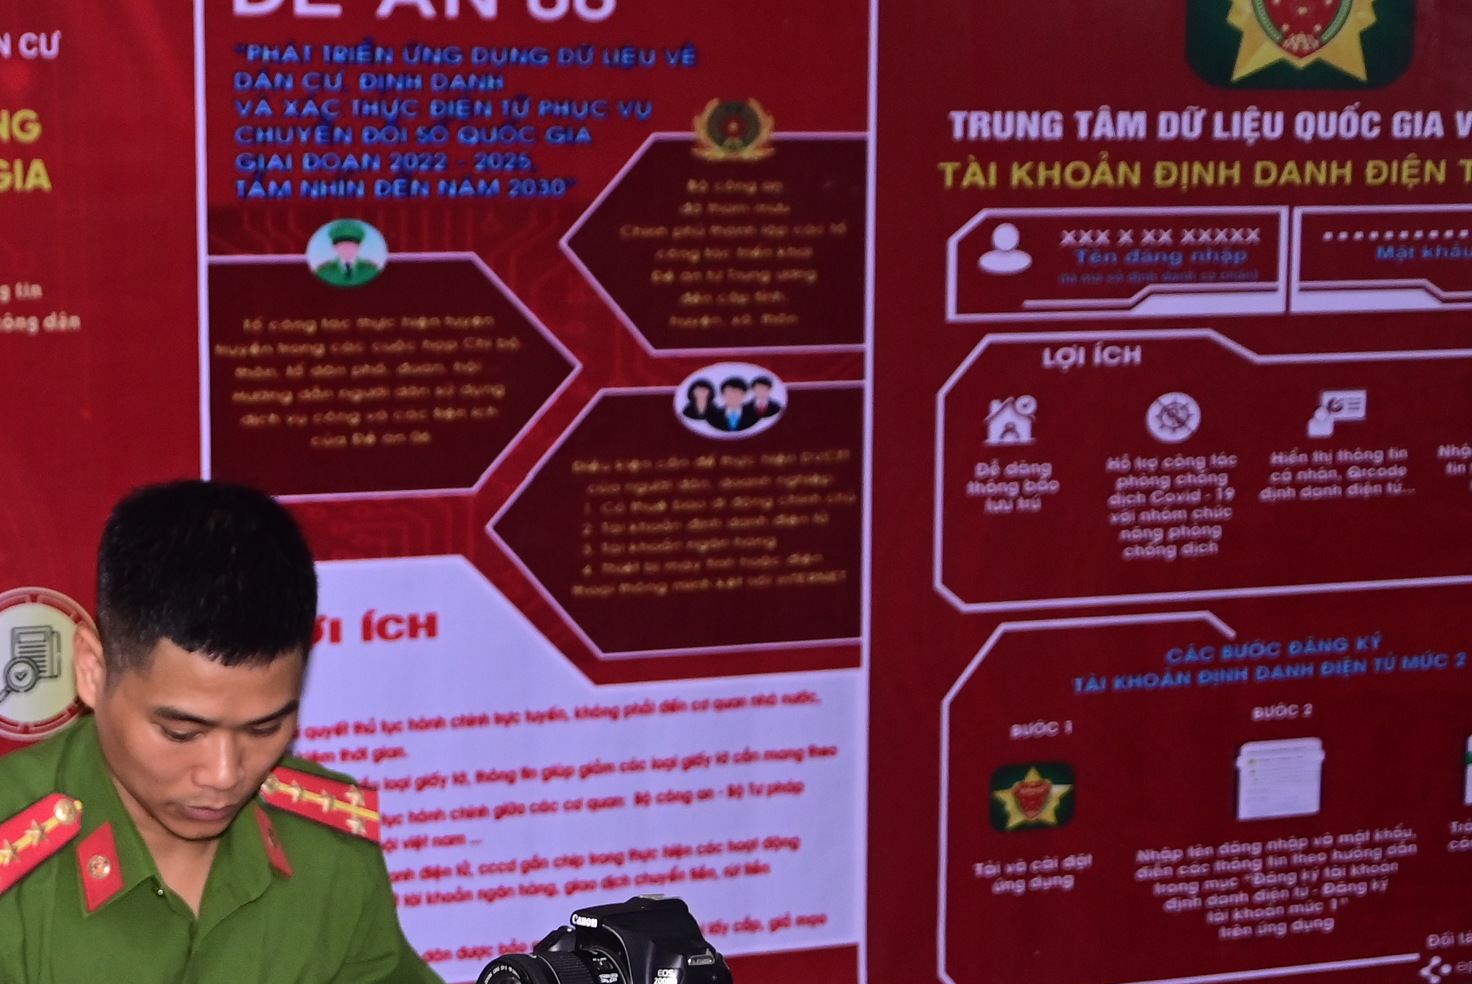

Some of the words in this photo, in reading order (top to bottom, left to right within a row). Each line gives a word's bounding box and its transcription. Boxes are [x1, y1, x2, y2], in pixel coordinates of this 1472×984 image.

[19, 30, 61, 59] CƯ
[949, 111, 1063, 140] TRUNG
[1074, 105, 1147, 140] TÂM
[1158, 106, 1207, 140] DỮ
[1213, 106, 1284, 145] LIỆU
[1295, 102, 1381, 142] QUỐC
[1392, 111, 1444, 139] GIA
[390, 152, 449, 172] 2022
[939, 155, 997, 188] TÀI
[1011, 152, 1141, 188] KHOẢN
[1154, 161, 1241, 190] ĐỊNH
[1254, 161, 1352, 186] DANH
[1365, 153, 1446, 188] ĐIỆN
[15, 282, 42, 298] tin
[1043, 345, 1085, 370] LỢI
[1092, 342, 1142, 366] ÍCH
[361, 607, 438, 642] ÍCH
[571, 914, 598, 928] Canon
[657, 969, 675, 977] EOS
